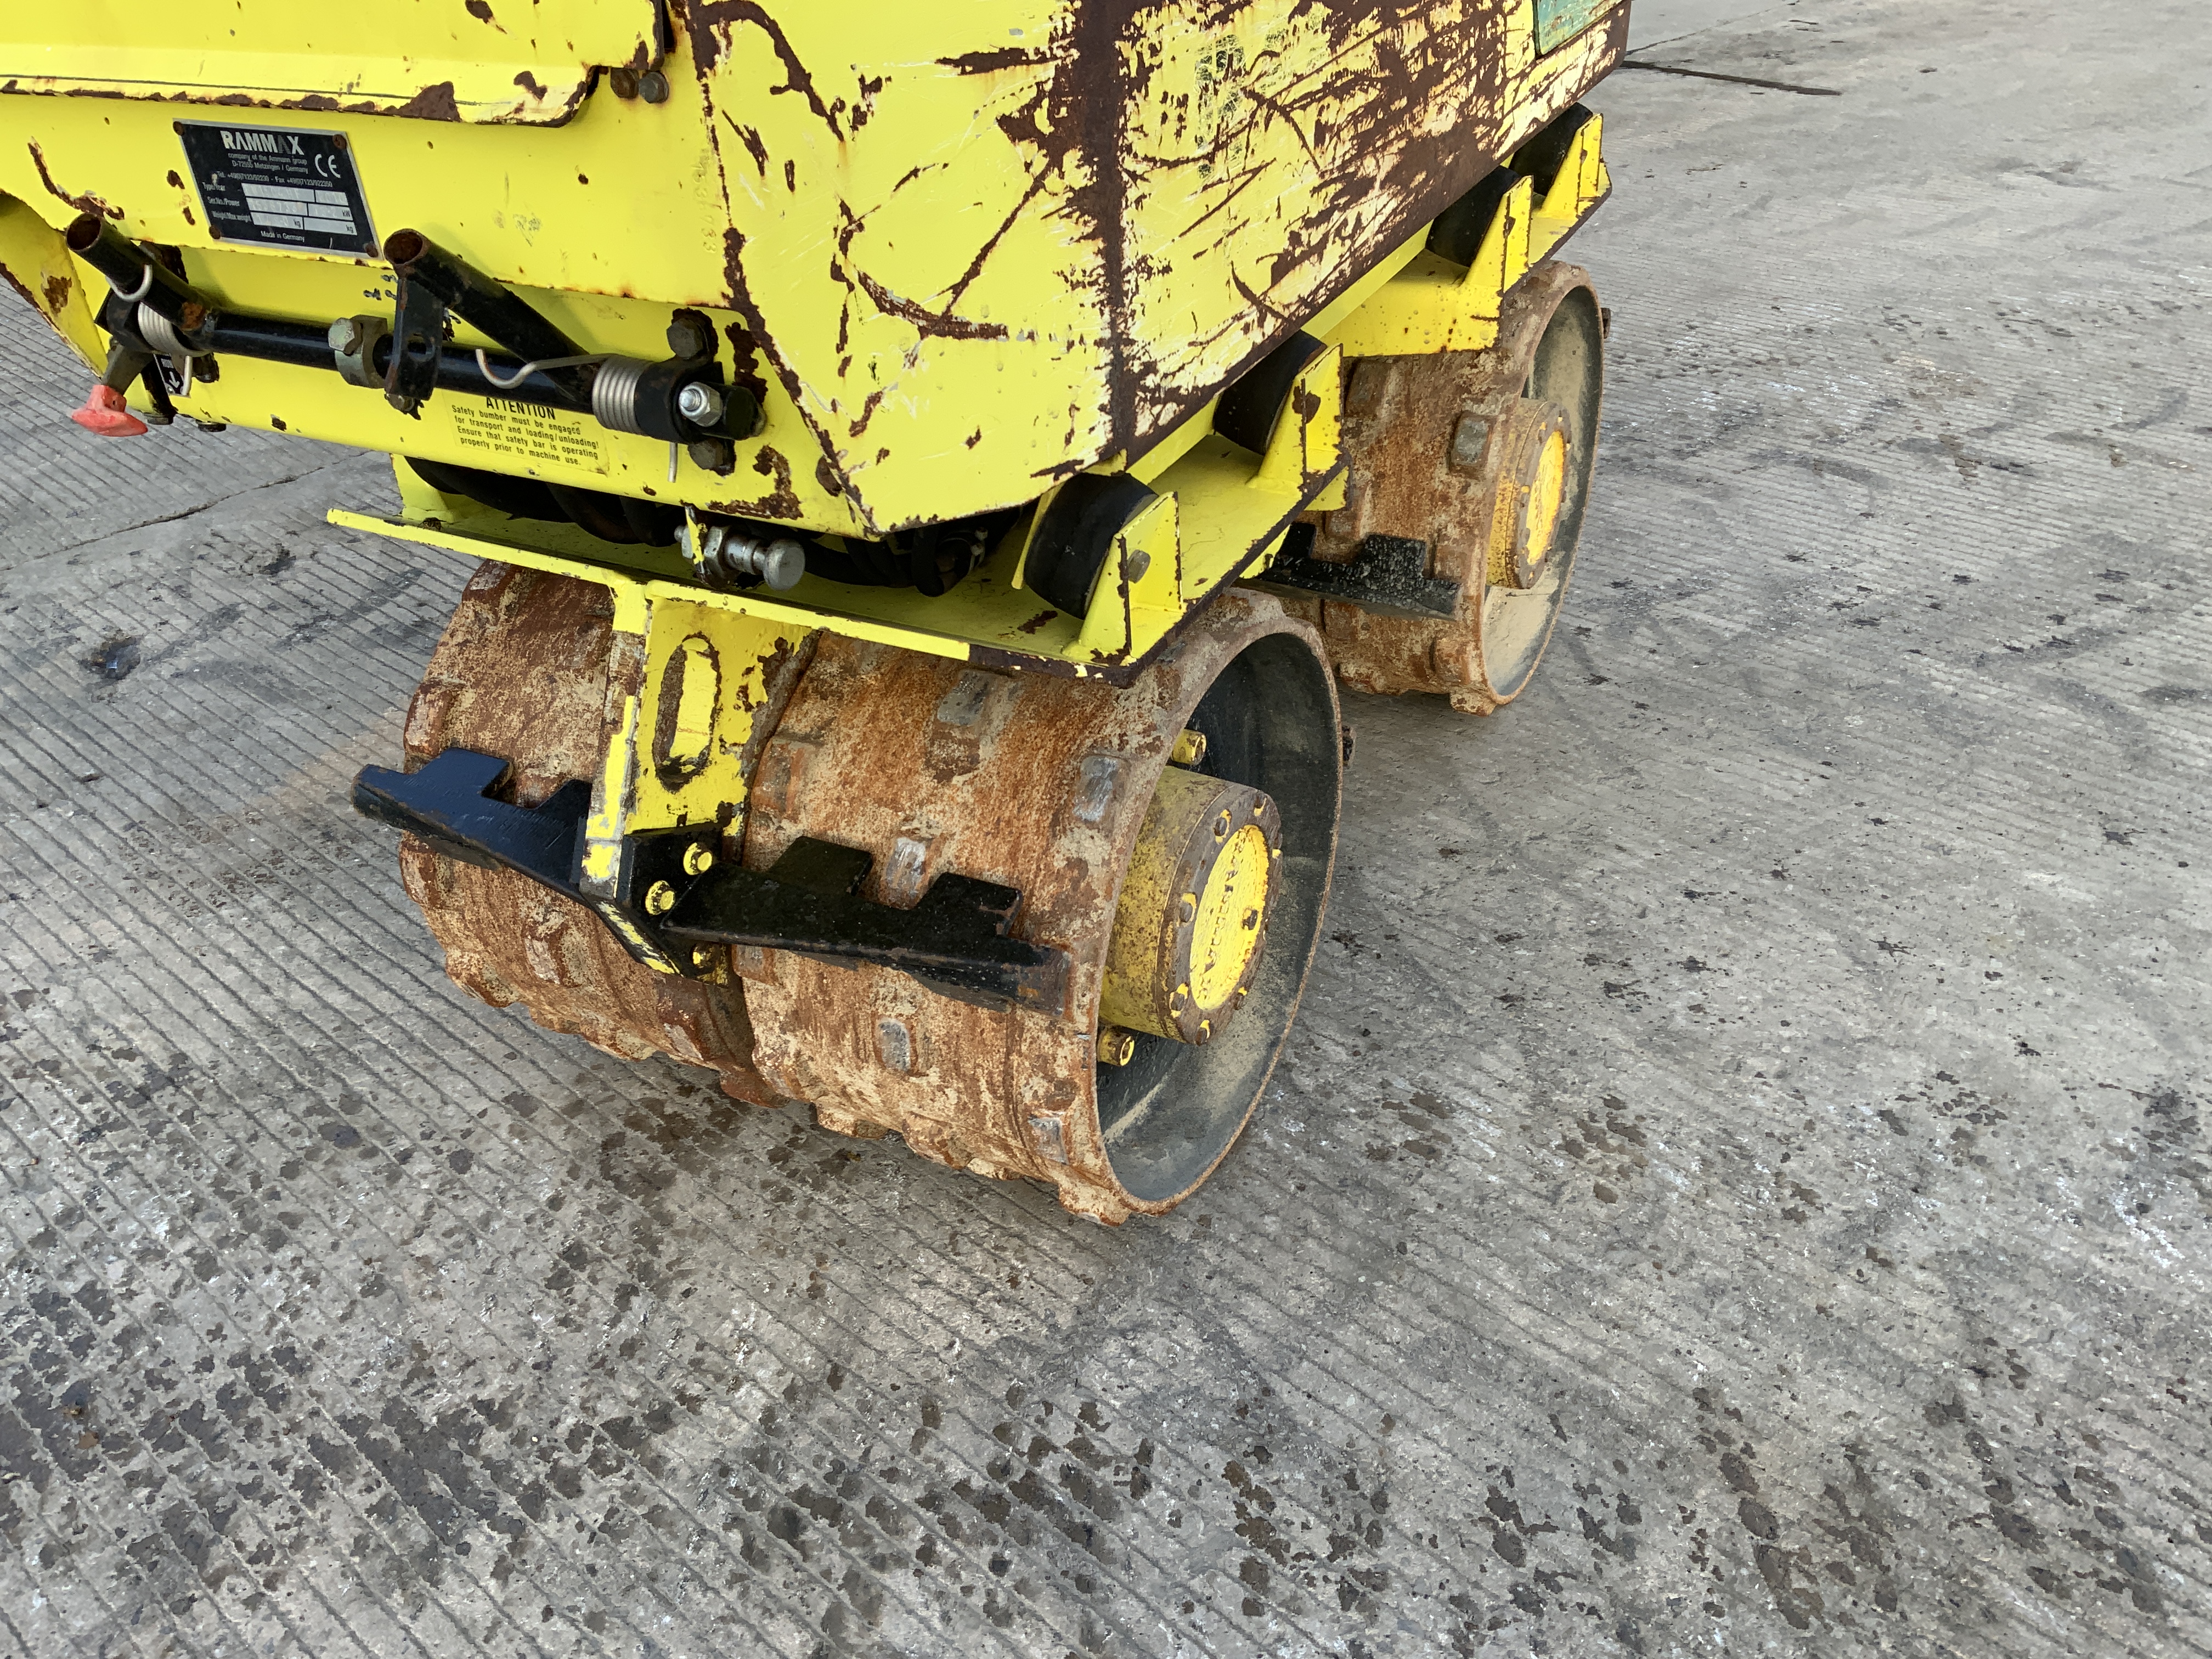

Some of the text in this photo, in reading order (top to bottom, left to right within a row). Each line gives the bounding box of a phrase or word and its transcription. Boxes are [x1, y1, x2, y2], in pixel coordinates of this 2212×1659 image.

[220, 131, 304, 155] RAMMAX
[254, 162, 280, 171] Metzingen
[286, 165, 308, 174] Germany
[315, 154, 341, 178] CE
[283, 233, 305, 243] Germany
[294, 219, 301, 228] kg
[346, 225, 353, 233] kg
[452, 404, 581, 435] Safety bumber must be engaged
[486, 397, 556, 420] ATTENTION
[455, 415, 465, 424] for
[469, 418, 504, 431] transport
[526, 428, 599, 449] loading/unloading!
[457, 426, 598, 460] Ensure that safety bar is operating
[460, 437, 582, 465] properly prior to machine use.
